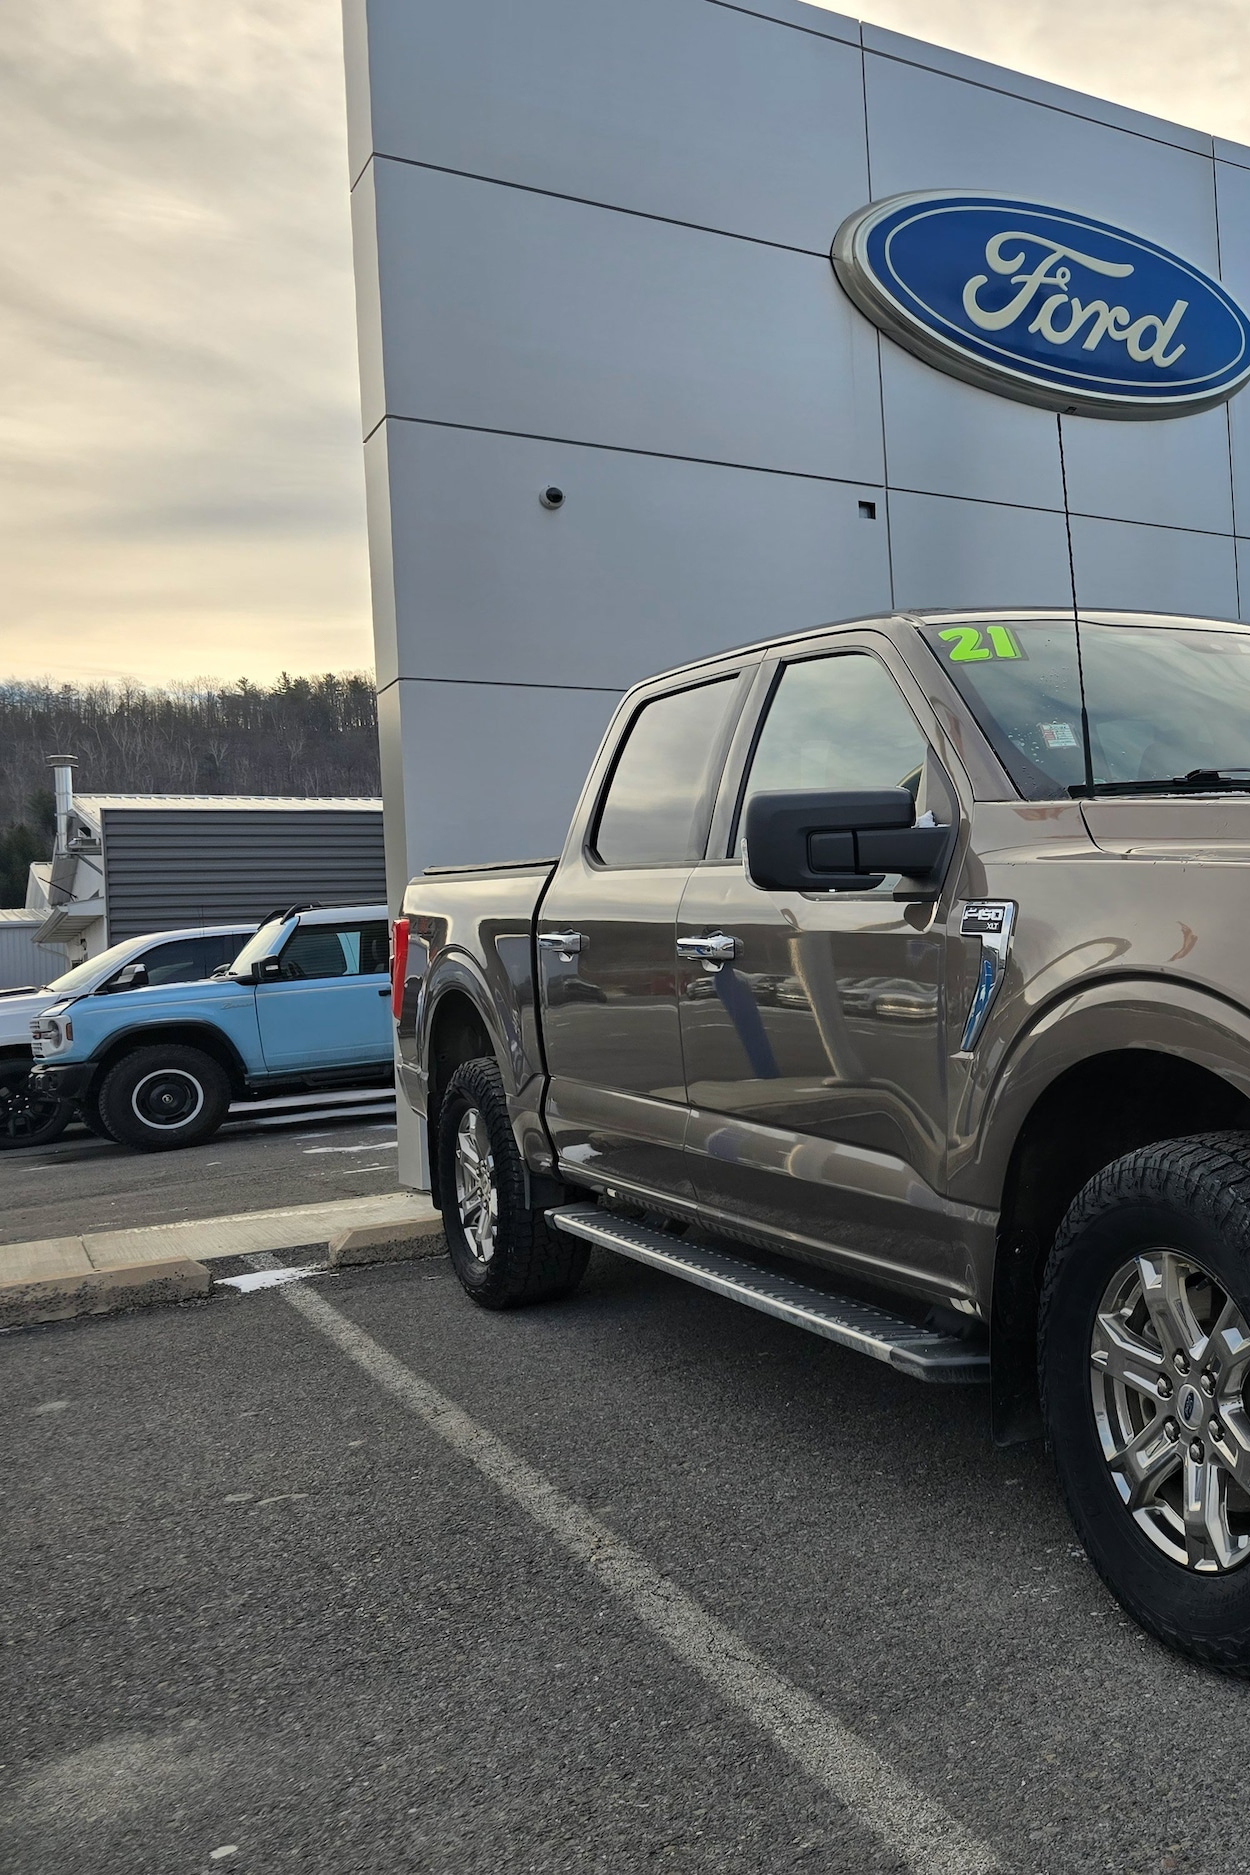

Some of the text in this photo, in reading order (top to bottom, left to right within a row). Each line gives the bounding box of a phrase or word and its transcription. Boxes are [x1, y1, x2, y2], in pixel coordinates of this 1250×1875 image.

[963, 231, 1189, 368] Ford
[938, 625, 1021, 662] 21
[963, 907, 1004, 920] F-150
[986, 922, 999, 930] XLT
